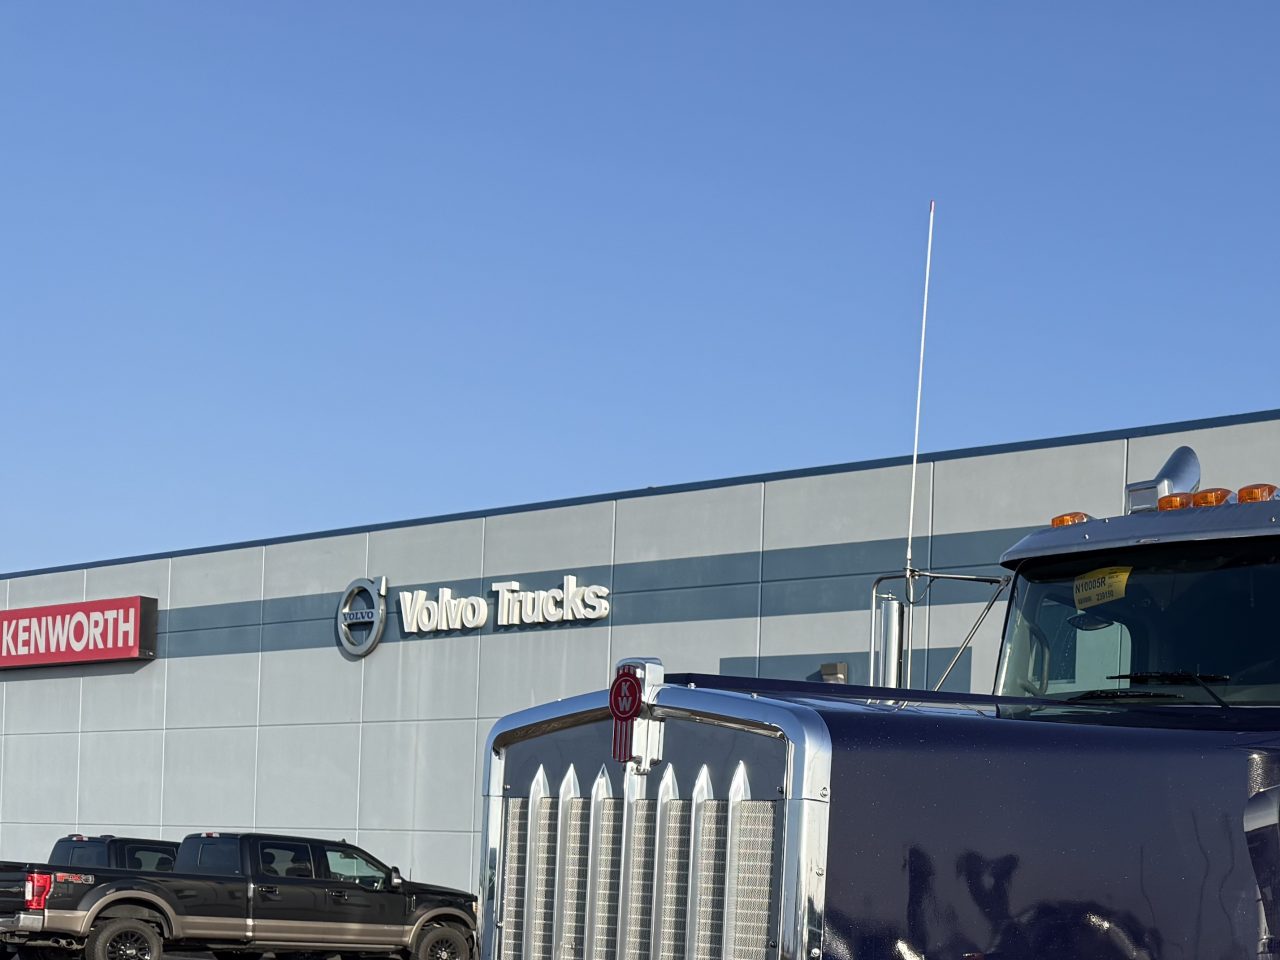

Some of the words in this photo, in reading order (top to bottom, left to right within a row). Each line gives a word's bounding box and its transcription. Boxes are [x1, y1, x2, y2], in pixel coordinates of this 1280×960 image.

[399, 587, 488, 633] Volvo
[492, 575, 609, 626] Trucks
[342, 610, 374, 622] VOLVO
[1, 607, 135, 657] KENWORTH
[620, 681, 630, 697] K
[617, 696, 633, 712] W
